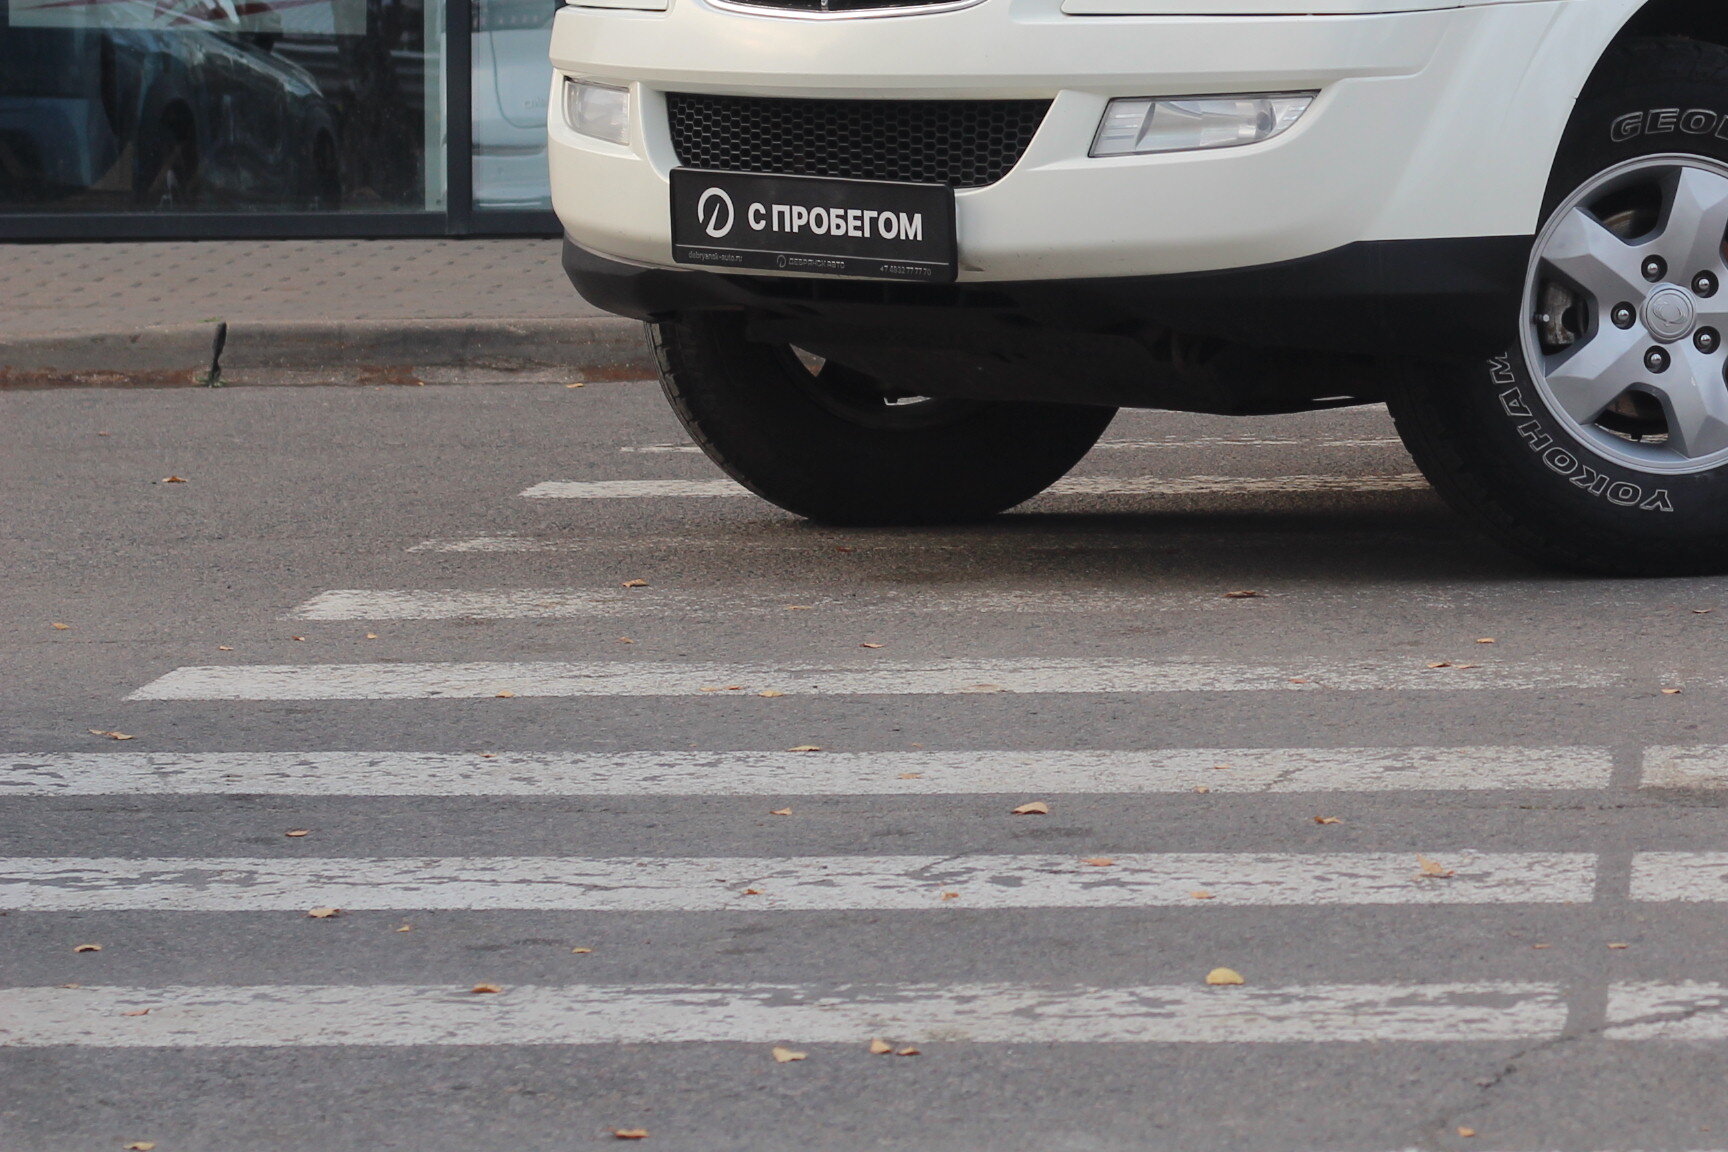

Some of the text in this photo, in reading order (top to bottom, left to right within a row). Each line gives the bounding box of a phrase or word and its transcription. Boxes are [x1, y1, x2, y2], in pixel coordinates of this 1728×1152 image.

[747, 202, 924, 241] С ПРОБЕГОМ
[1485, 351, 1674, 513] YOKOHAM
